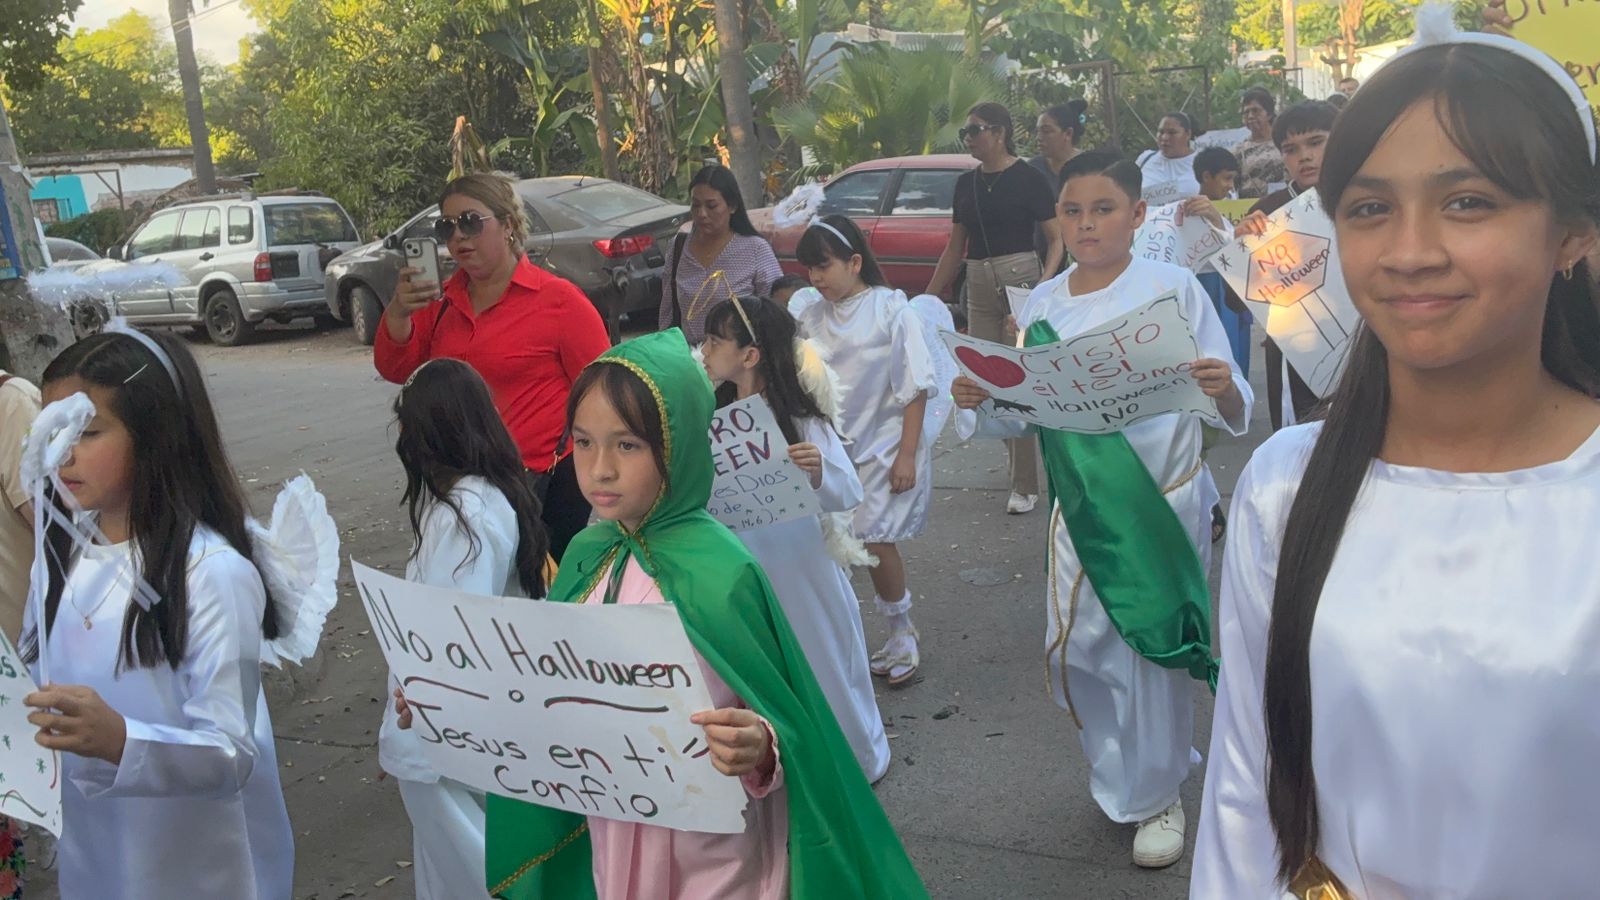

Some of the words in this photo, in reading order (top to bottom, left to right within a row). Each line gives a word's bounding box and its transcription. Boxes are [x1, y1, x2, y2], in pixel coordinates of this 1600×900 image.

[1258, 249, 1330, 300] Halloween
[1278, 254, 1296, 275] al
[1020, 323, 1161, 374] Cristo
[1049, 378, 1188, 413] Halloween
[1071, 378, 1116, 395] te
[724, 501, 742, 514] de
[752, 492, 775, 506] la
[446, 605, 492, 672] al
[492, 617, 692, 688] Halloween
[405, 699, 528, 760] Jesus
[549, 742, 612, 774] en
